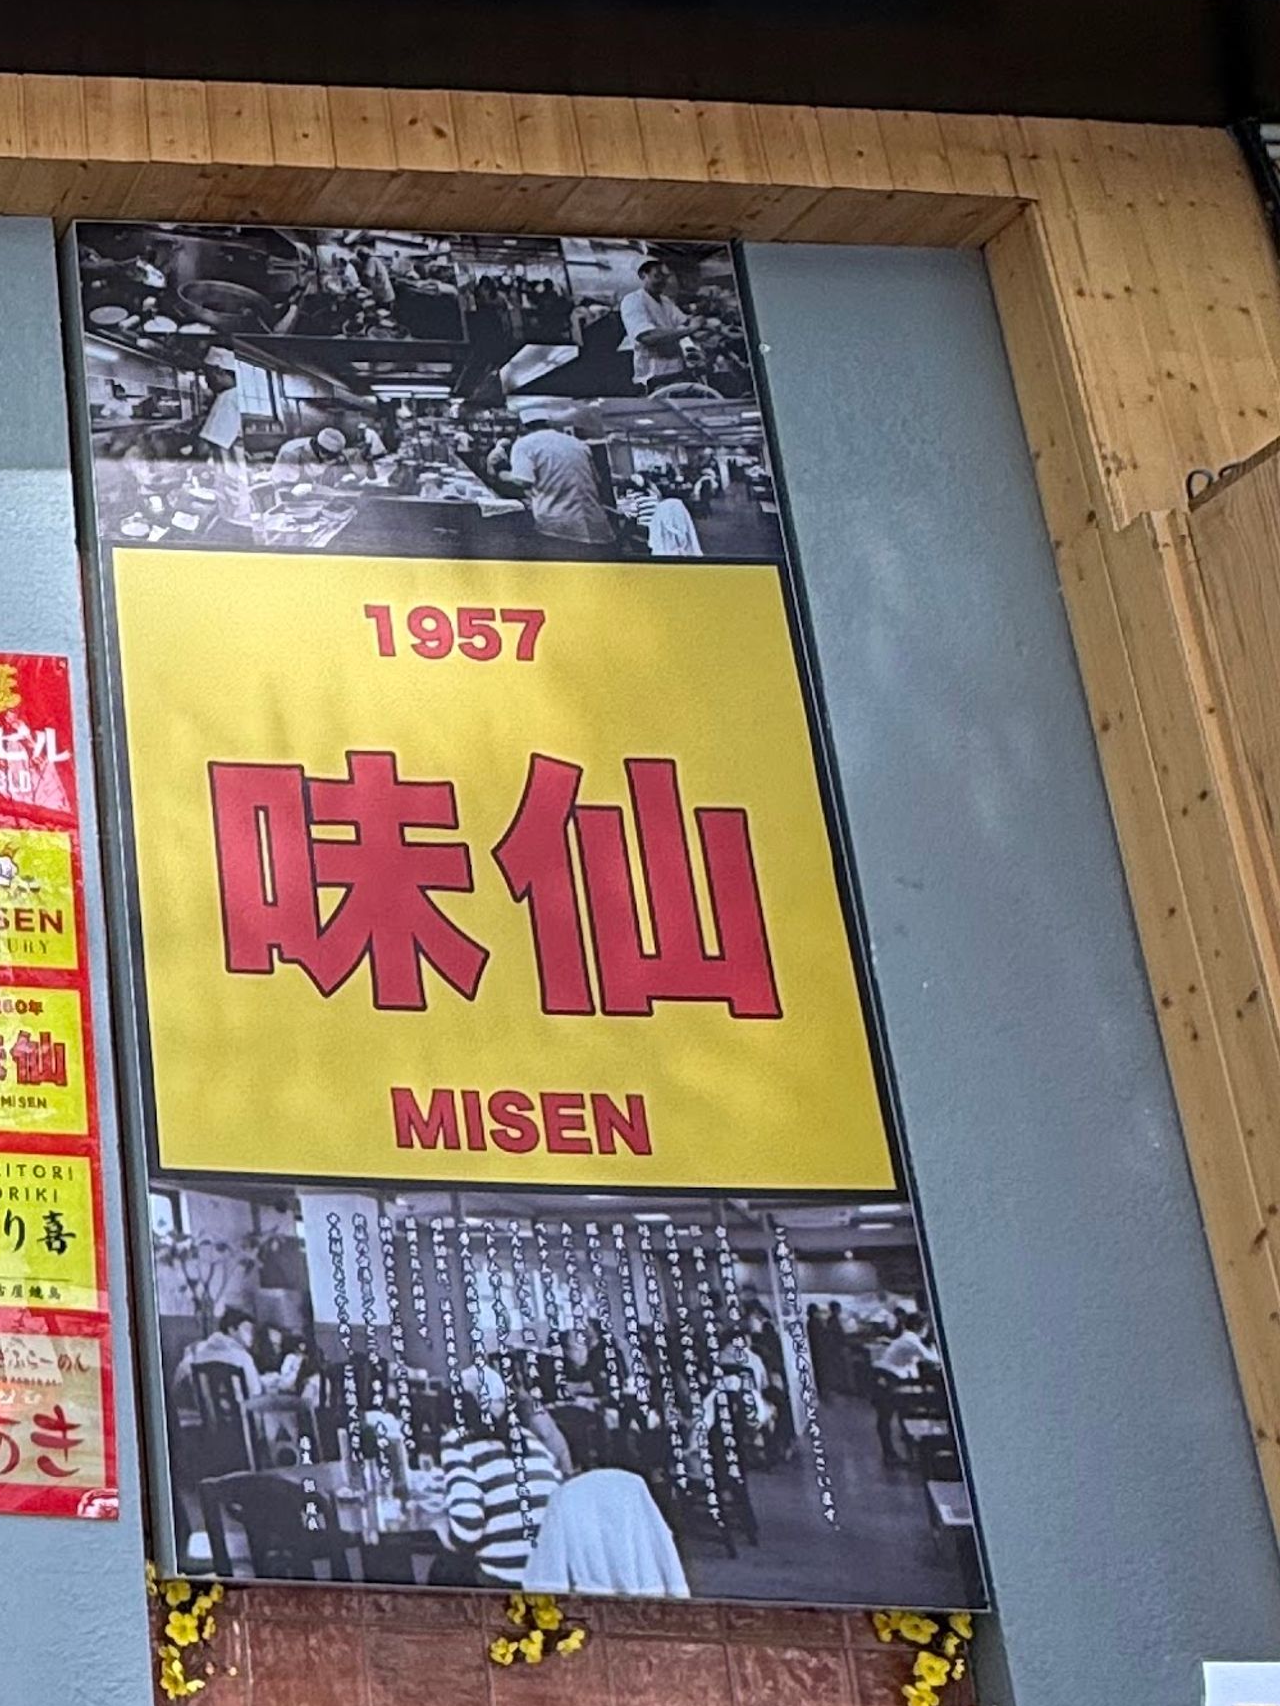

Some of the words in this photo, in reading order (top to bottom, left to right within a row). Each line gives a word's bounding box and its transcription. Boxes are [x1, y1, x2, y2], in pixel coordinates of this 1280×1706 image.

[363, 603, 547, 663] 1957
[206, 750, 785, 1021] 味仙
[0, 1096, 48, 1109] MISEN
[388, 1087, 655, 1157] MISEN
